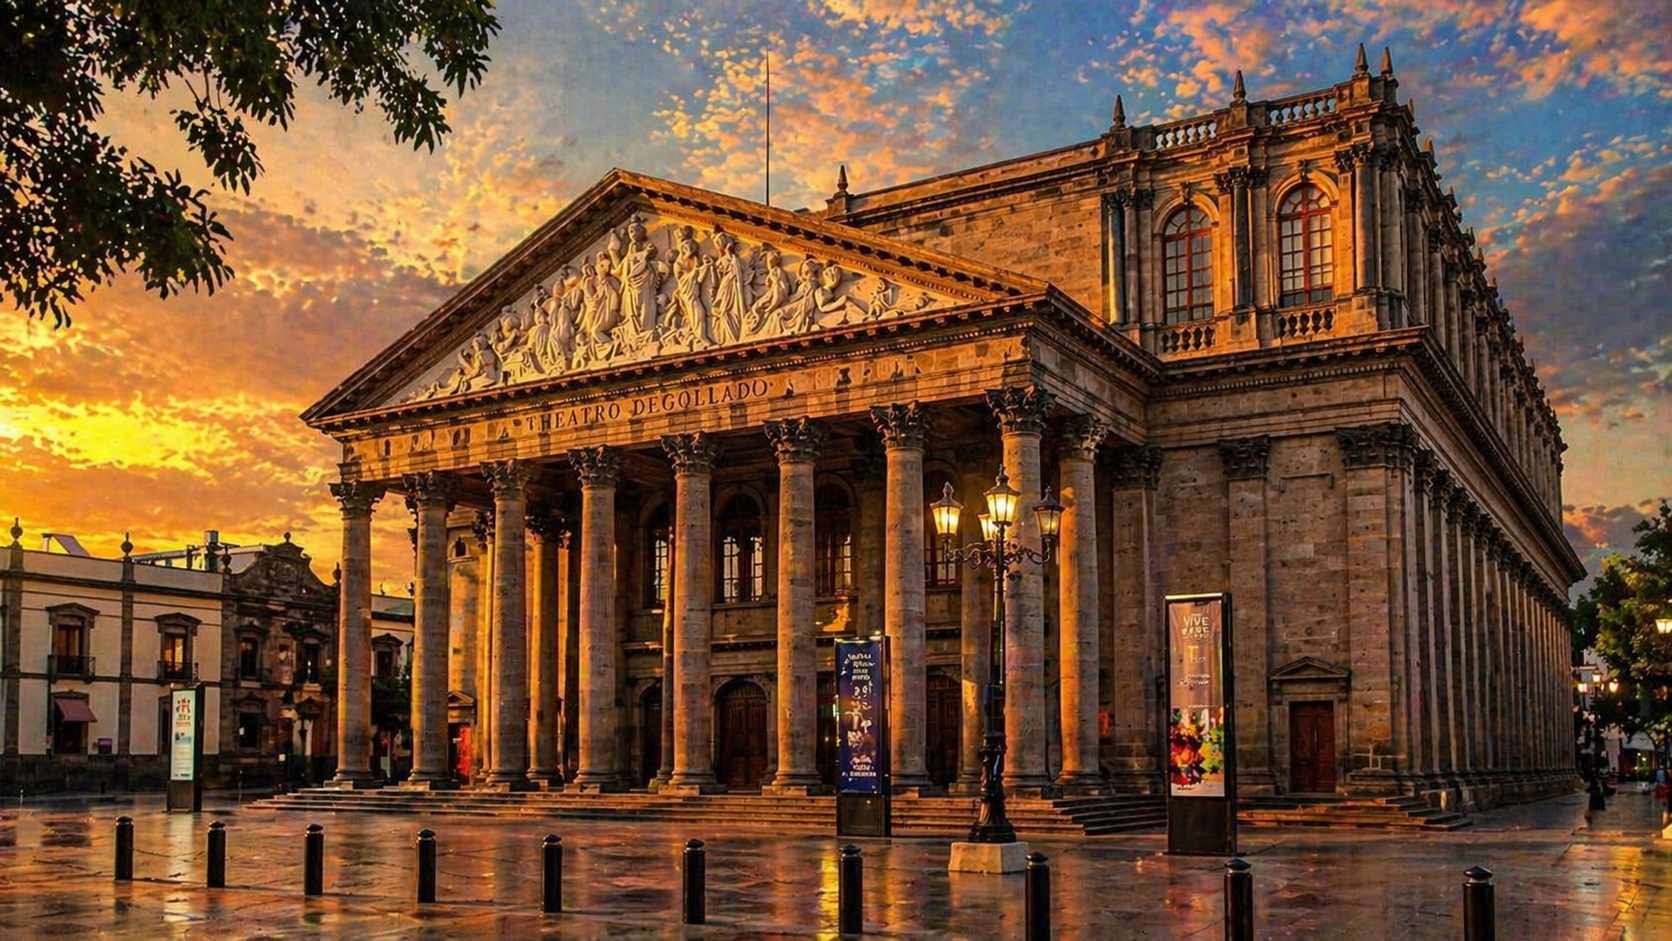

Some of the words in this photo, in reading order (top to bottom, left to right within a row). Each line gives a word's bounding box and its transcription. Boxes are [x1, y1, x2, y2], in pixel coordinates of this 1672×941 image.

[526, 402, 620, 431] THEATRO
[631, 379, 768, 416] DEGOLLADO
[1183, 615, 1209, 628] VIVE
